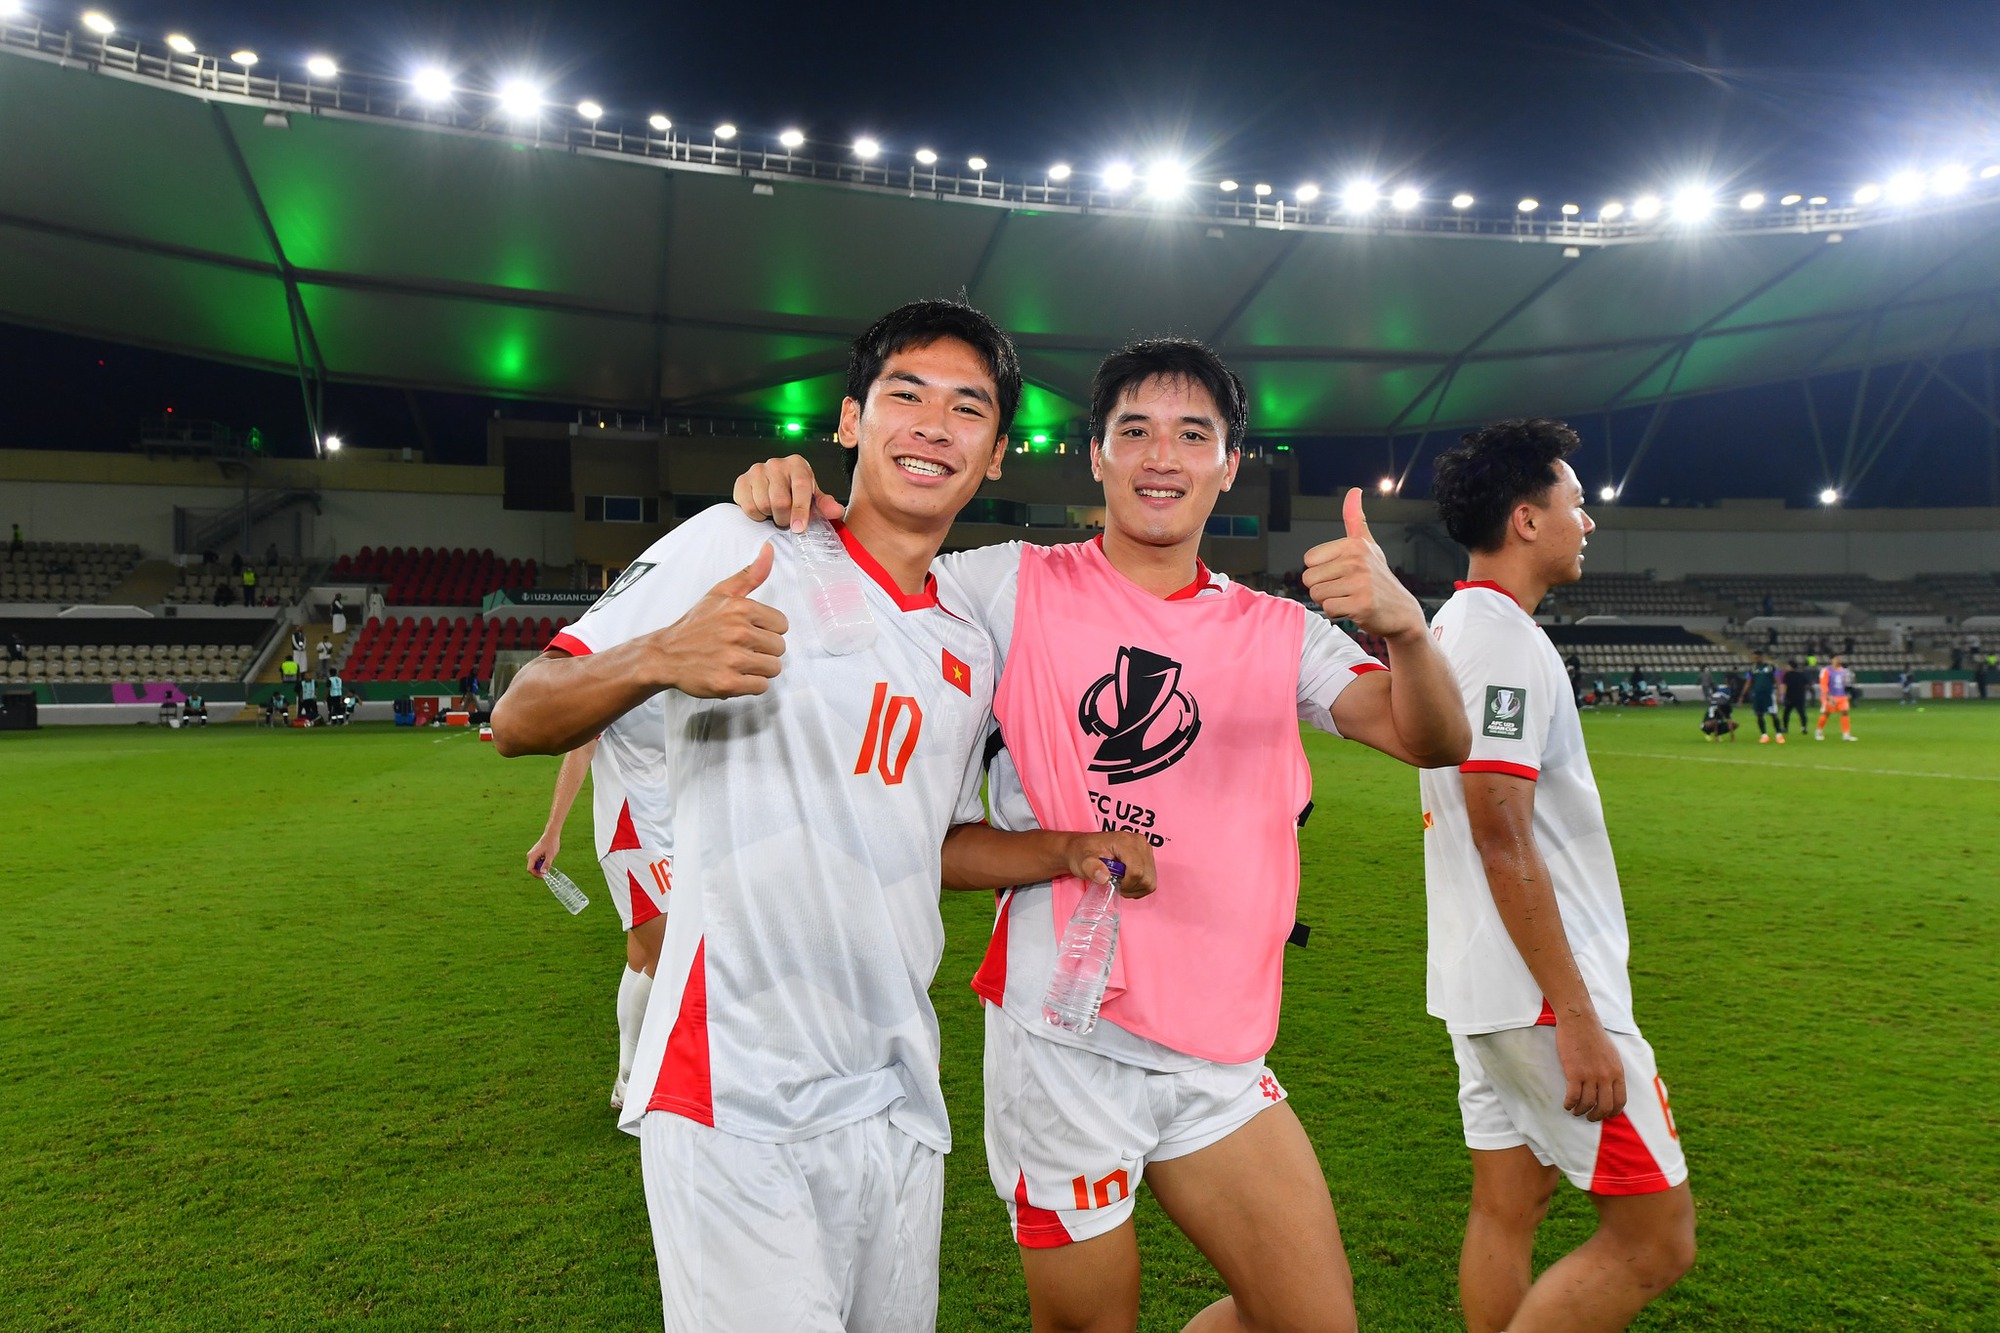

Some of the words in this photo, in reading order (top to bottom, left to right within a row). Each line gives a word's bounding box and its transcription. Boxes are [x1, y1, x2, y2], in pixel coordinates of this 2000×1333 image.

[534, 593, 551, 601] U23
[552, 593, 579, 601] ASIAN
[580, 593, 599, 601] CUP
[854, 682, 923, 786] 10
[1088, 790, 1112, 815] FC
[1115, 800, 1156, 828] U23
